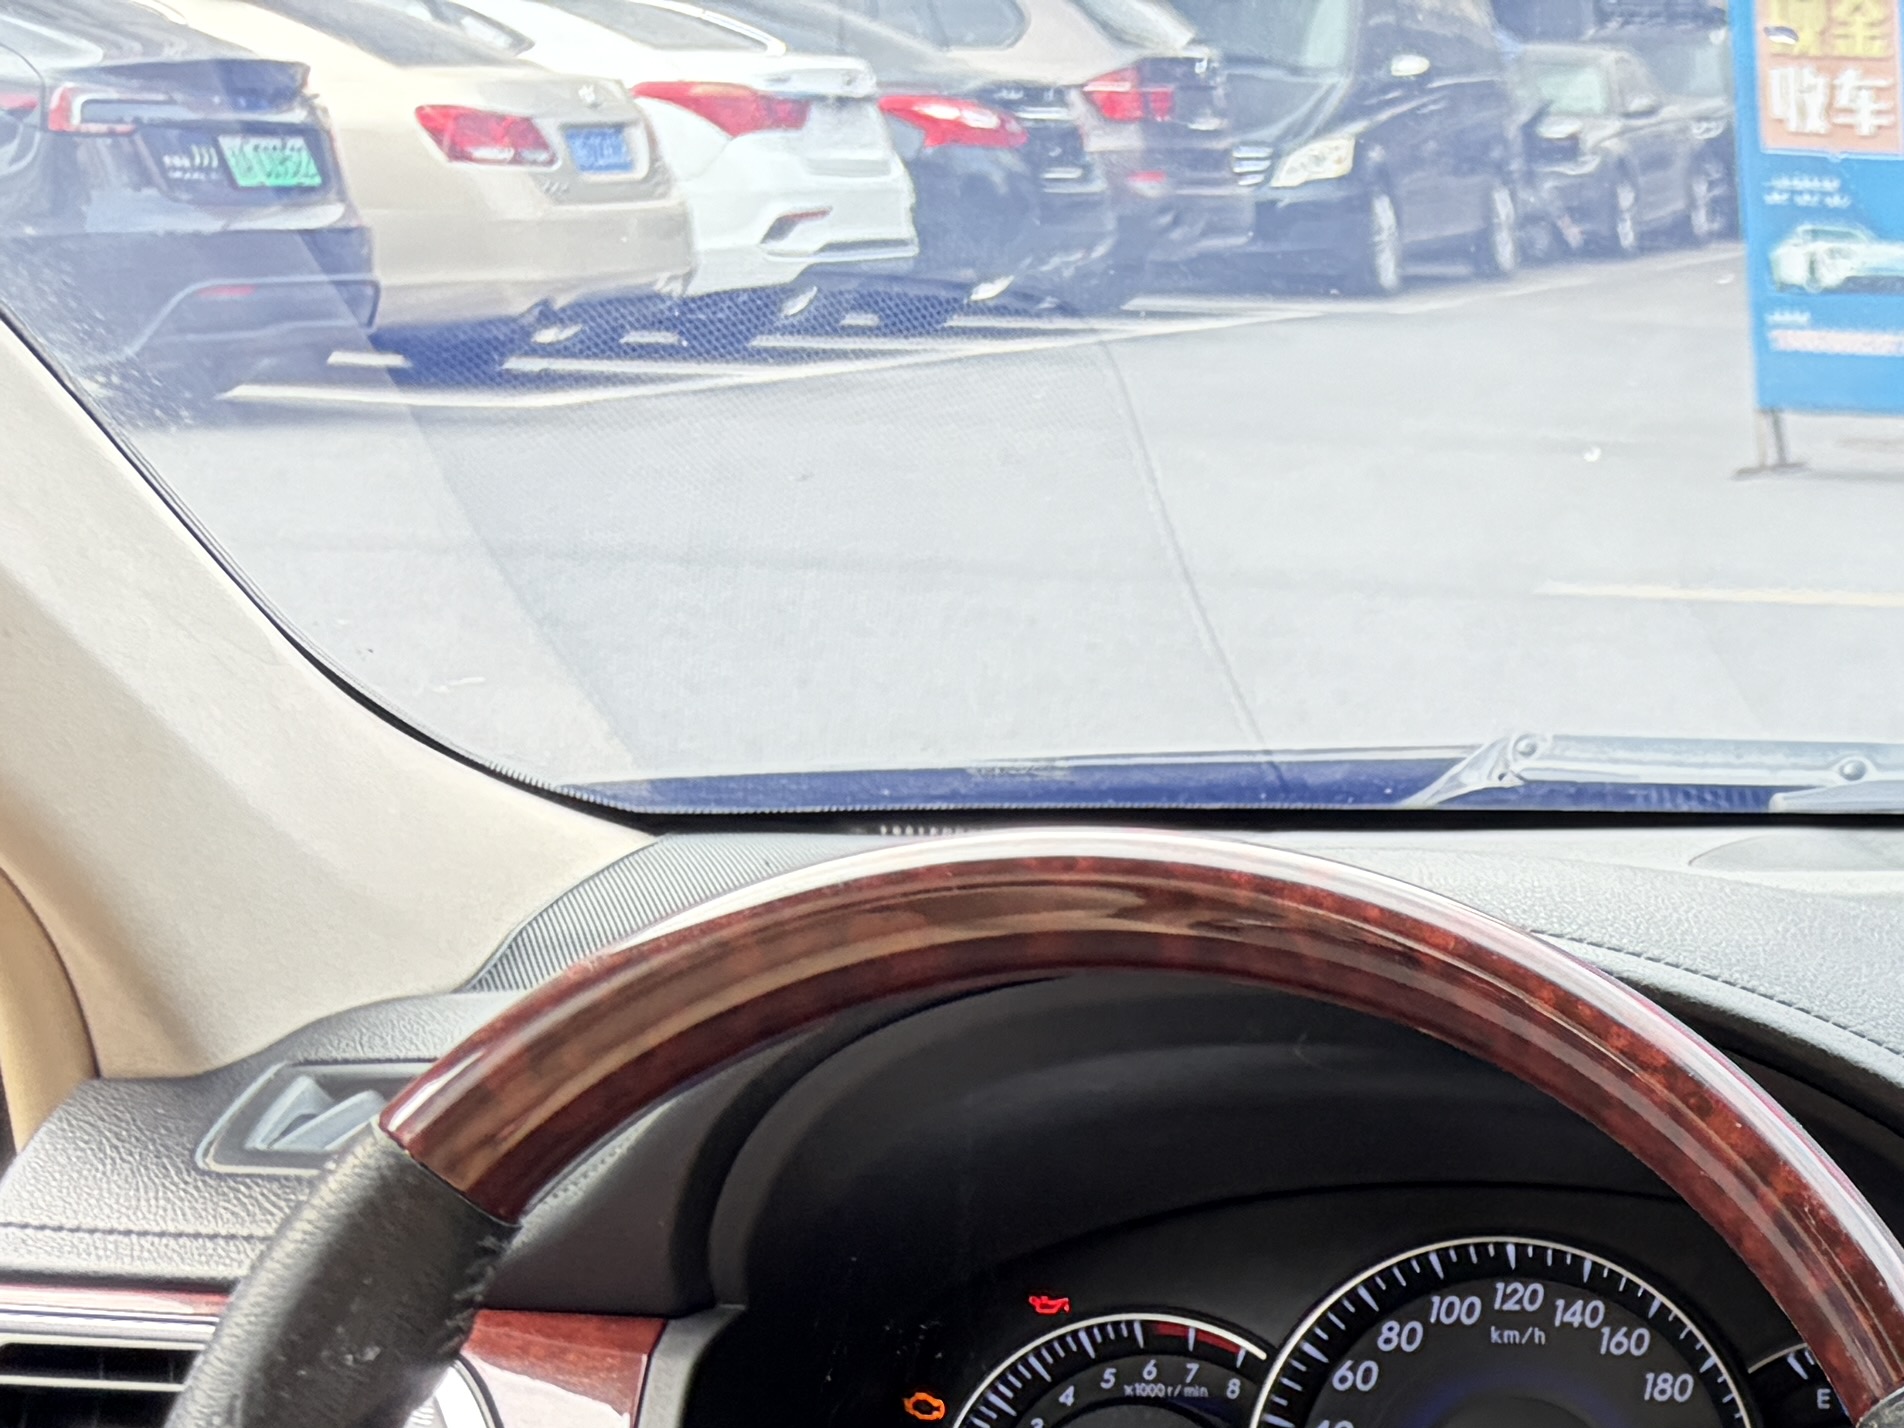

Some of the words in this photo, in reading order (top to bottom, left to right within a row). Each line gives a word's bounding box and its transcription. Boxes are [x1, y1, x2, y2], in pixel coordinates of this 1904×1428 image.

[1493, 1281, 1545, 1312] 120
[1429, 1295, 1482, 1326] 100
[1554, 1299, 1606, 1329] 140
[1377, 1320, 1424, 1353] 80
[1490, 1326, 1546, 1345] km/h
[1599, 1326, 1650, 1356] 160
[1100, 1368, 1117, 1389] 5
[1142, 1359, 1158, 1380] 6
[1185, 1363, 1200, 1383] 7
[1331, 1359, 1380, 1391] 60
[1058, 1385, 1075, 1406] 4
[1226, 1378, 1241, 1399] 8
[1643, 1372, 1695, 1403] 180
[1816, 1388, 1831, 1410] E
